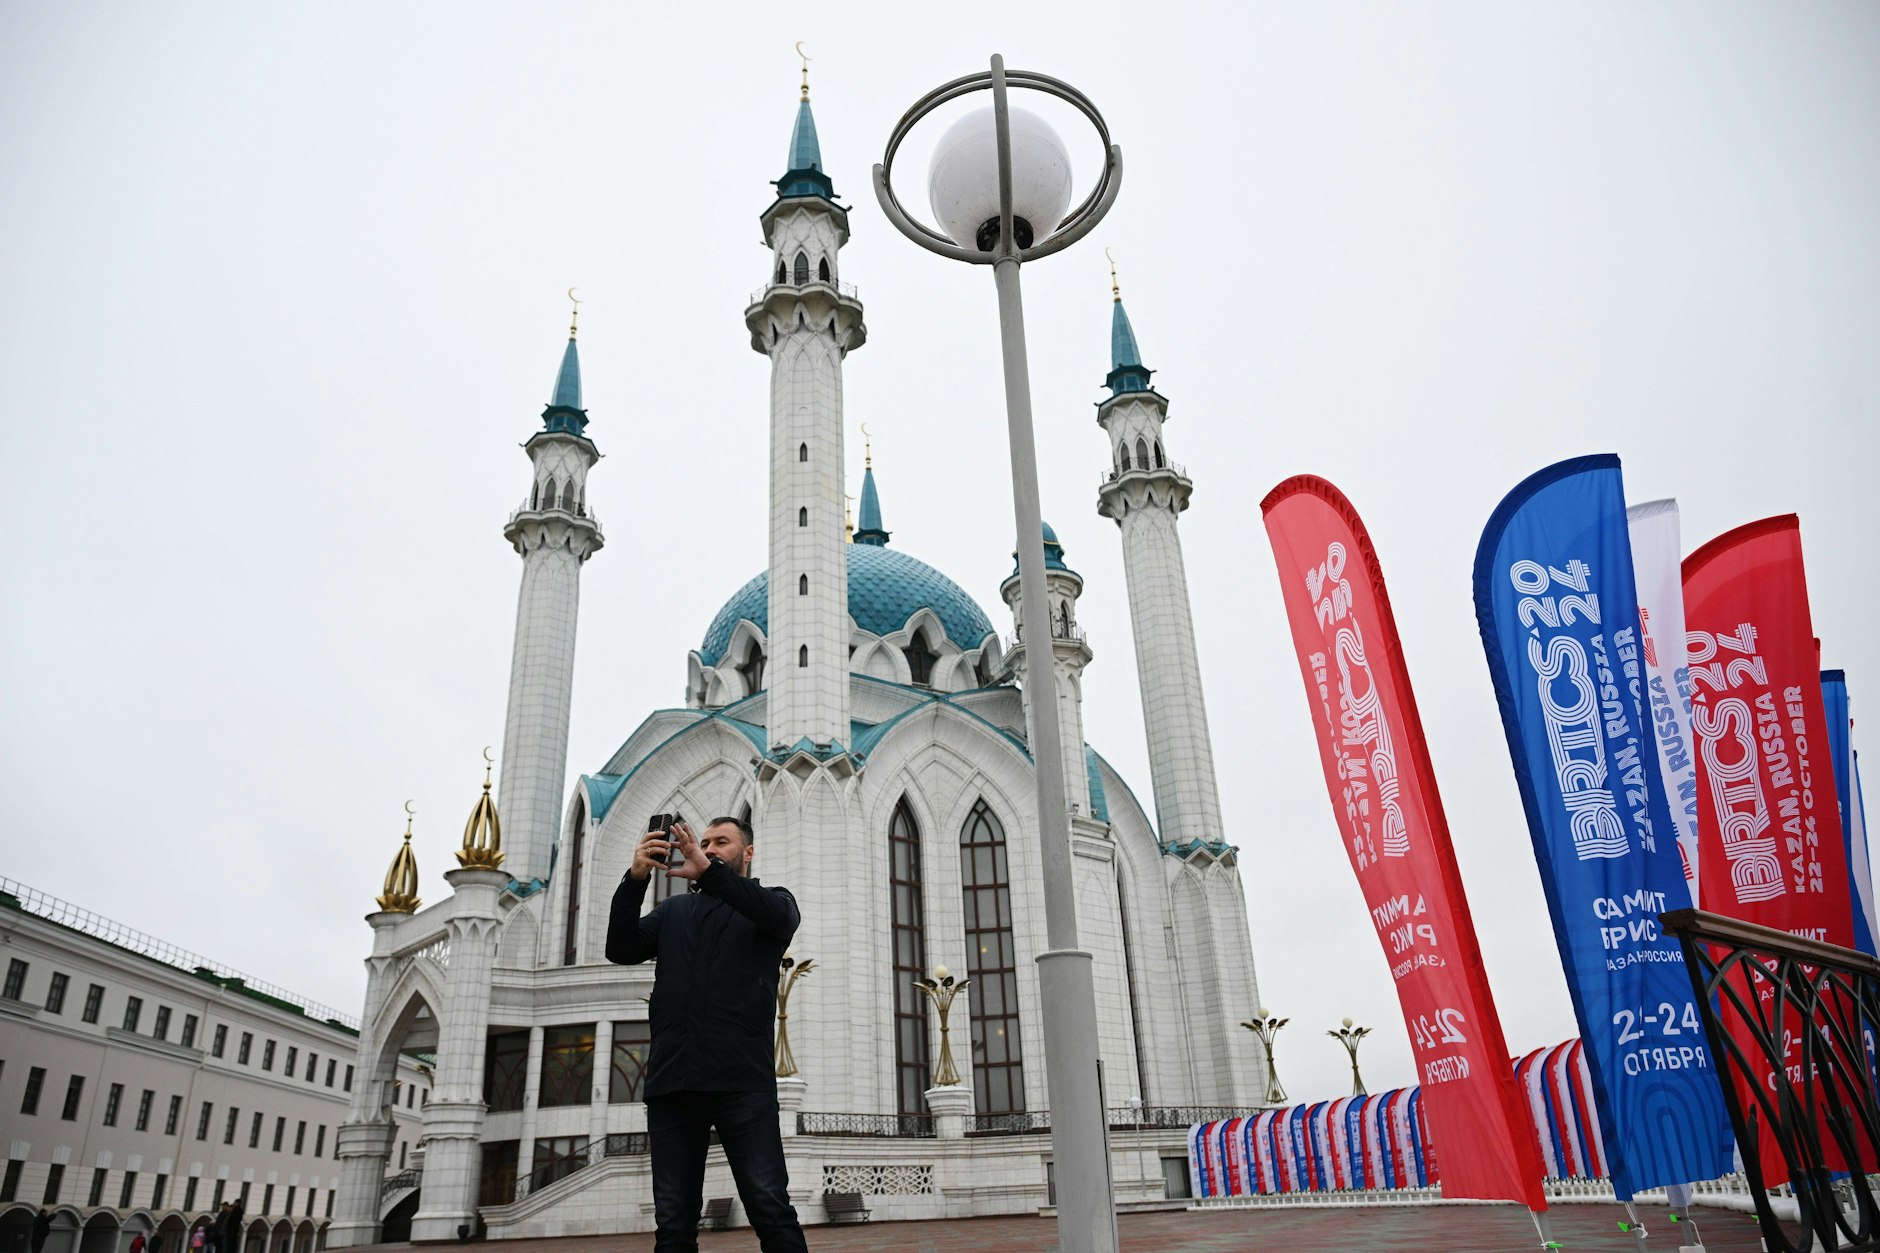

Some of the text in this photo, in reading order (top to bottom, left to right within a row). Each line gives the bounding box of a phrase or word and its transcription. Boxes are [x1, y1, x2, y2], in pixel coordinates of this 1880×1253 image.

[1527, 635, 1631, 861] BRICS
[1590, 633, 1631, 739] RUSSIA
[1649, 674, 1692, 774] RUSSIA
[1783, 685, 1816, 811] OCTOBER
[1692, 697, 1787, 904] BRICS
[1754, 691, 1807, 894] KAZAN, RUSSIA
